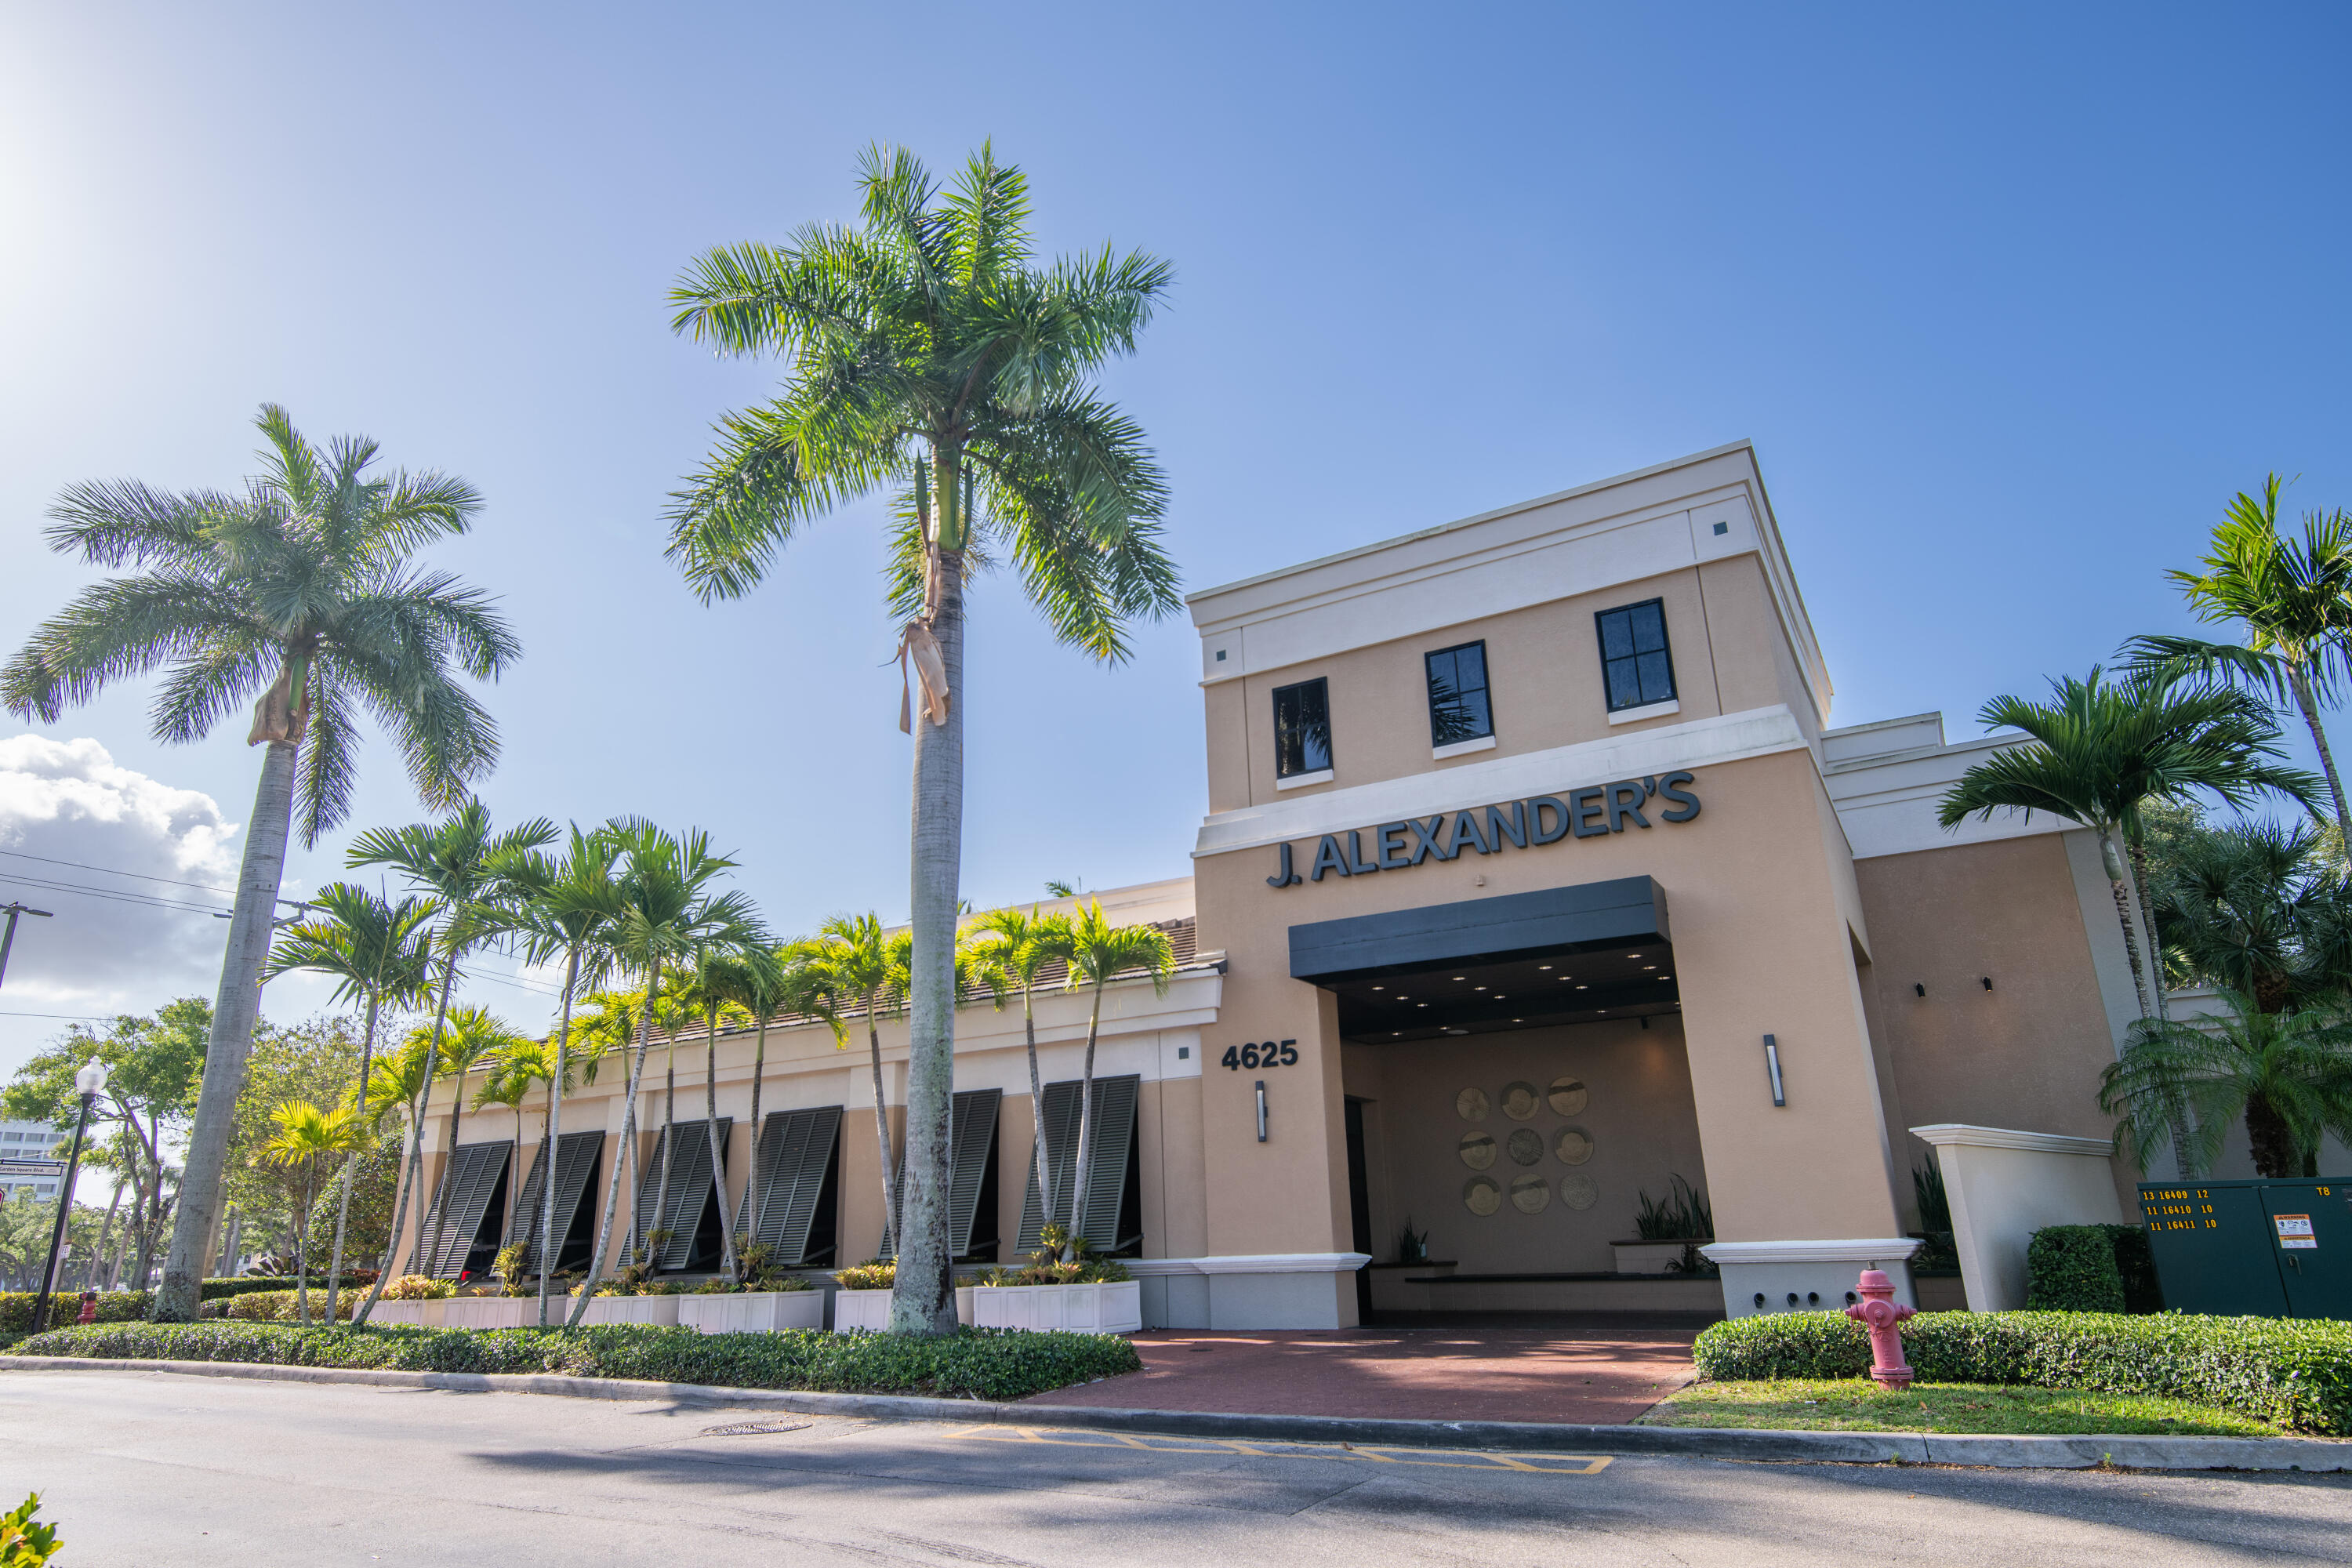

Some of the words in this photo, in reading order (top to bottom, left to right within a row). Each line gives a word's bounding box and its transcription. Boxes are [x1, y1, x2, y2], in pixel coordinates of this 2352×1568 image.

[1266, 843, 1303, 888] J.
[1310, 771, 1701, 882] ALEXANDER'S
[1221, 1039, 1298, 1071] 4625
[2143, 1191, 2155, 1200] 13
[2159, 1190, 2188, 1200] 16409
[2197, 1189, 2209, 1199] 12
[2316, 1186, 2331, 1196] T8
[2147, 1207, 2158, 1215] 11
[2162, 1205, 2192, 1214] 16410
[2201, 1204, 2213, 1214] 10
[2151, 1222, 2162, 1231] 11
[2166, 1220, 2196, 1230] 16411
[2205, 1219, 2217, 1229] 10
